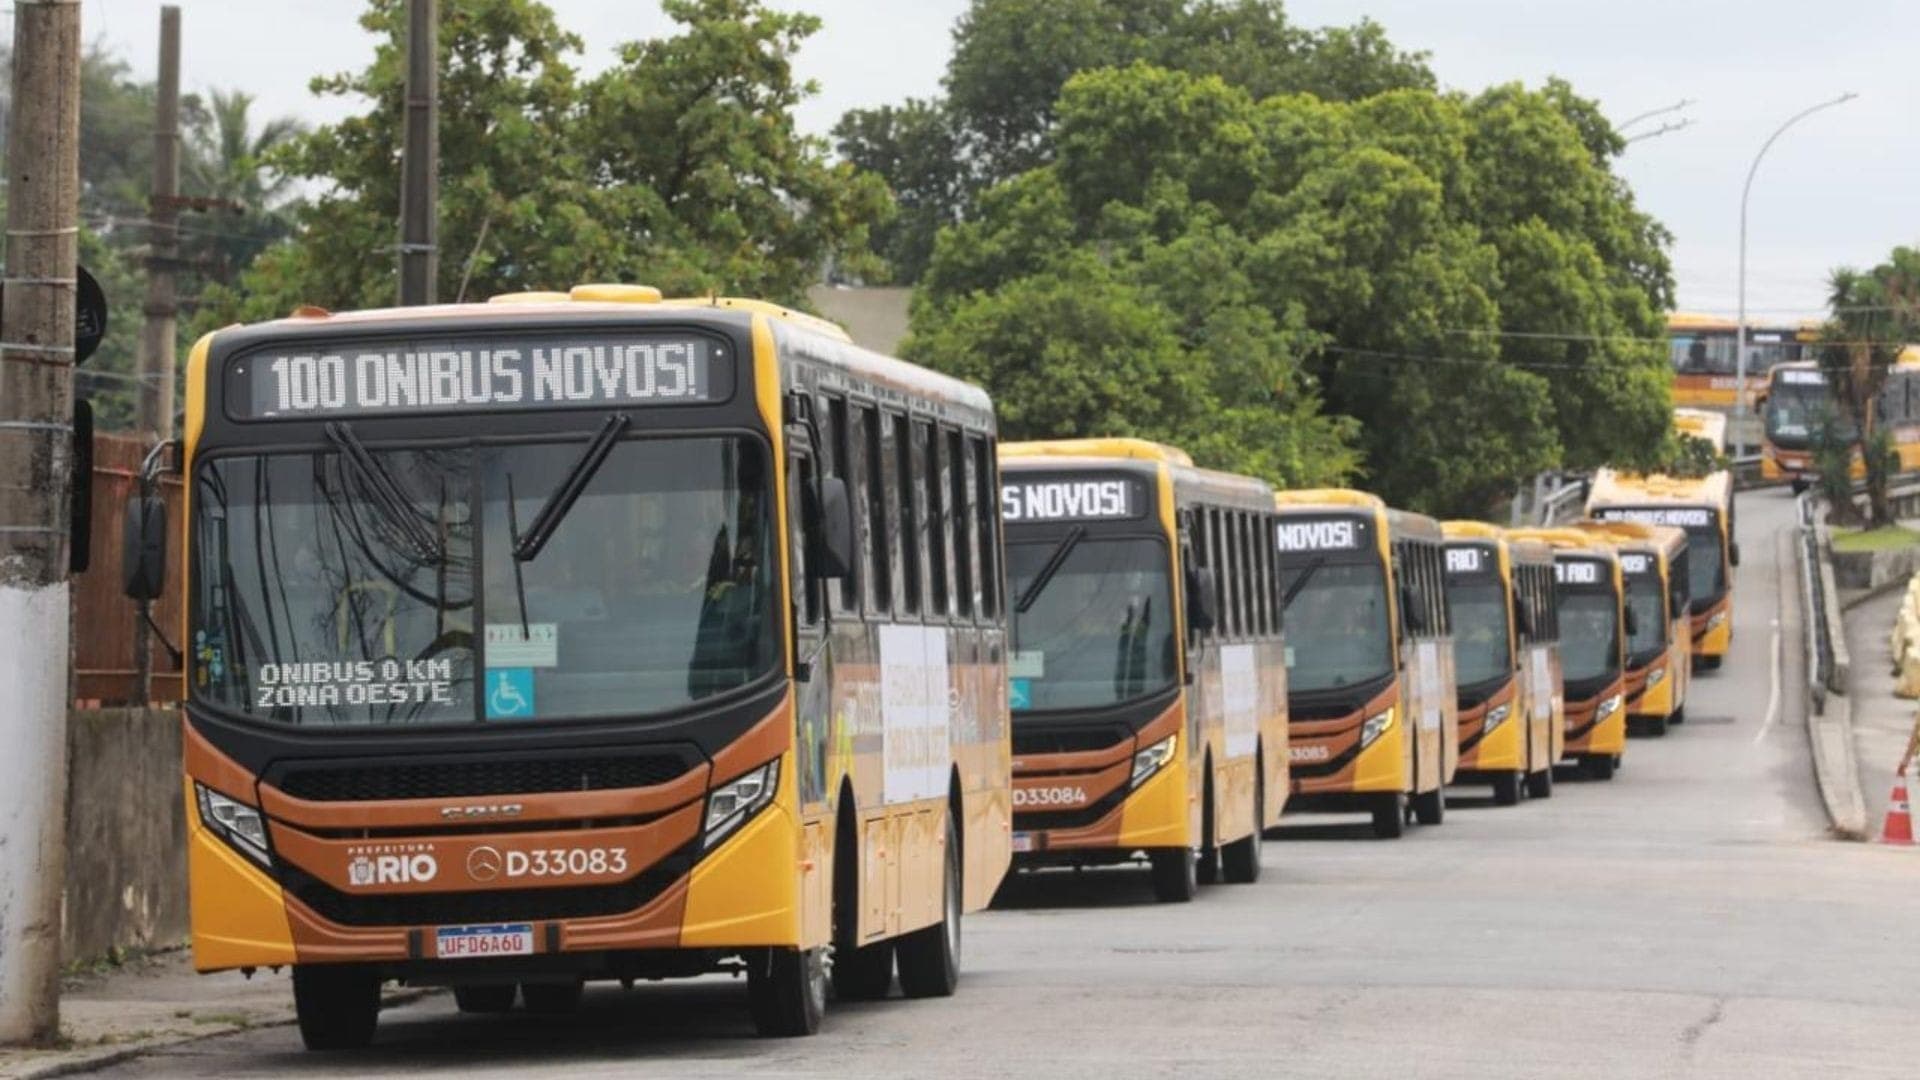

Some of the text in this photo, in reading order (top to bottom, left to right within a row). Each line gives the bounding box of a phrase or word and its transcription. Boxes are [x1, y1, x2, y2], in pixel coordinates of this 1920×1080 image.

[271, 343, 697, 410] 100 ONIBUS NOVOS!
[1025, 481, 1126, 518] NOVOS!
[1277, 521, 1354, 551] NOVOS!
[1446, 549, 1478, 571] RIO
[260, 661, 374, 684] ONIBUS
[405, 658, 451, 680] KM
[257, 681, 451, 707] ZONA OESTE
[1012, 787, 1086, 806] D33084
[347, 843, 435, 855] PREFEITURA
[506, 848, 628, 877] D33083
[377, 854, 438, 884] RIO
